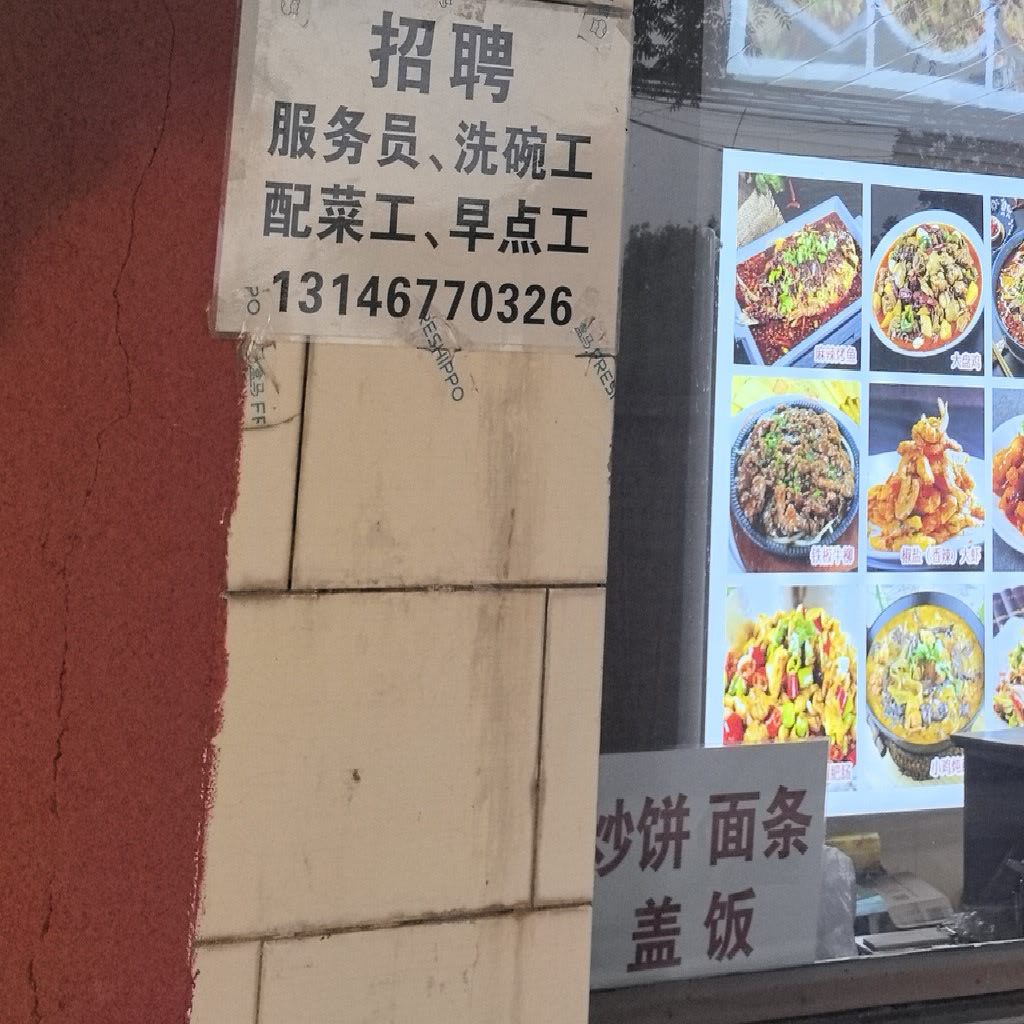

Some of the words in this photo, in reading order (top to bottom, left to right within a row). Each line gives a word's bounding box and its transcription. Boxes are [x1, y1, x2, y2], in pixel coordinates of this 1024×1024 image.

[368, 10, 515, 104] 招聘
[266, 100, 593, 181] 服务员、洗碗工
[262, 179, 590, 256] 配菜工、早点工
[272, 270, 574, 326] 13146770326
[950, 352, 982, 371] 大盘鸡
[930, 756, 965, 776] 小鸡炖
[626, 887, 756, 973] 盖饭
